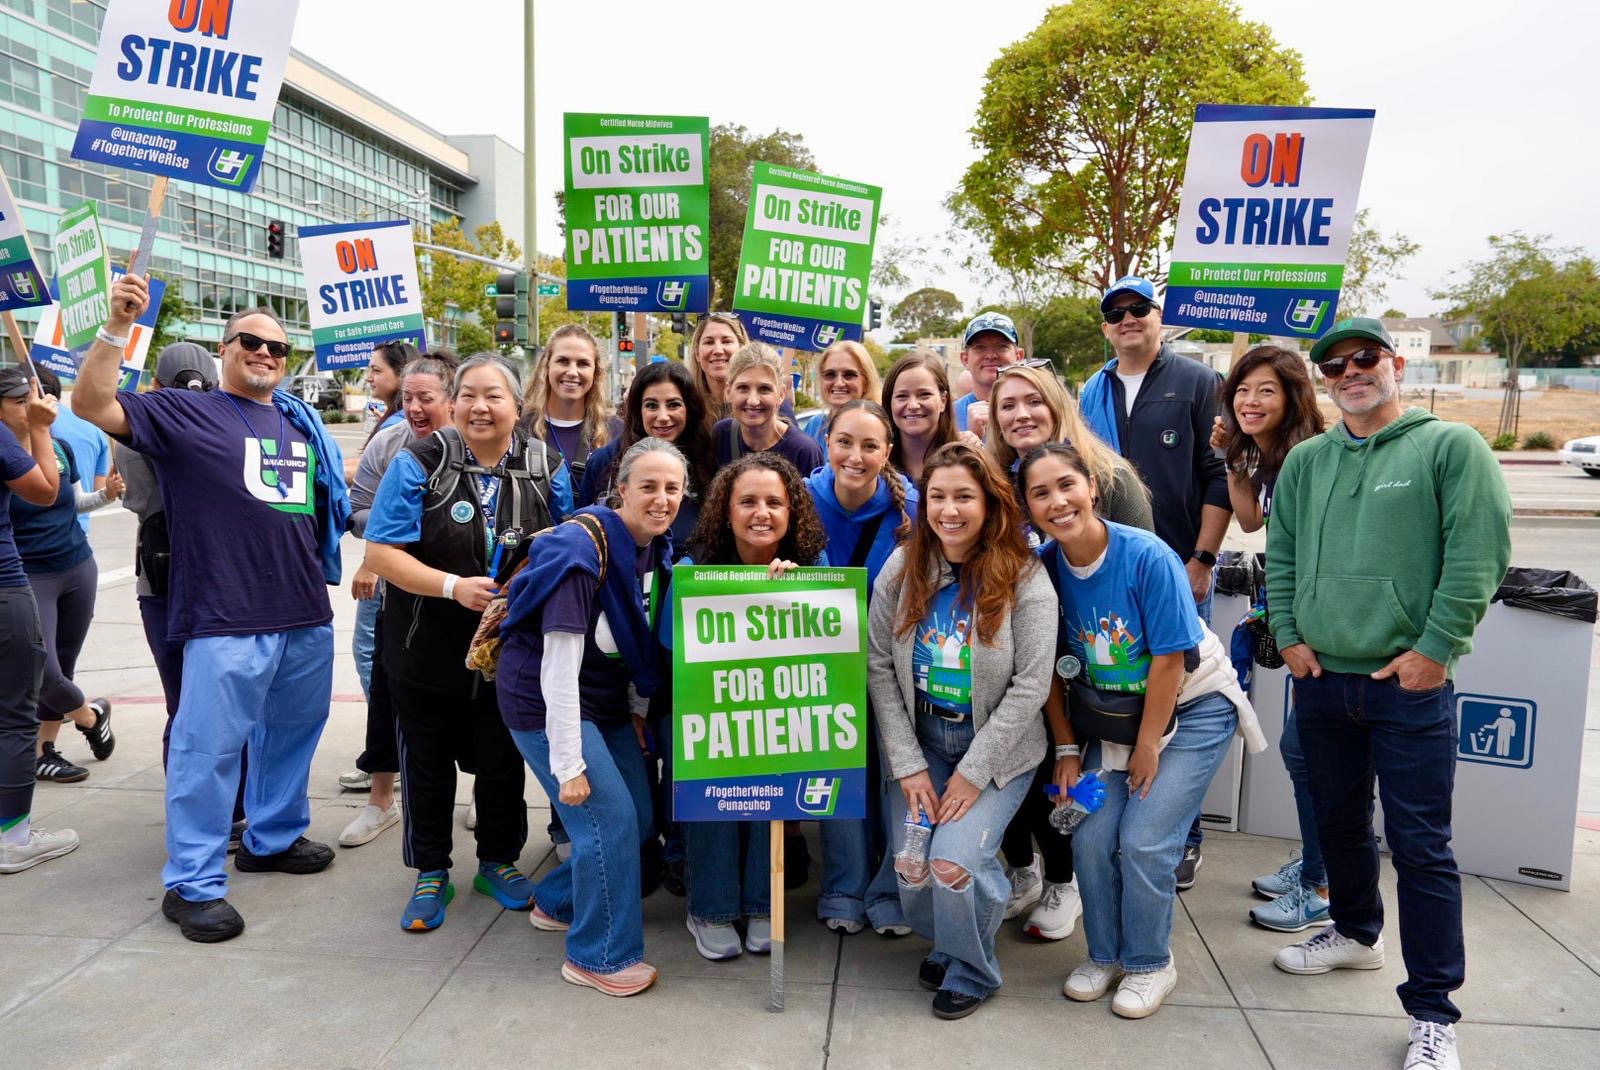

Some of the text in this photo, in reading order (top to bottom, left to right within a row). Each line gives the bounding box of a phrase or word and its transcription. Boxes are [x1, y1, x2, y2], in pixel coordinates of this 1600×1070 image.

[117, 34, 263, 101] STRIKE
[108, 103, 253, 137] To Protect Our Professions
[600, 118, 627, 128] Certified
[645, 119, 673, 129] Midwives
[91, 138, 190, 169] #TogetherWeRise
[111, 127, 177, 152] @unacuhcp
[580, 143, 690, 175] On Strike
[1241, 133, 1305, 188] ON
[594, 192, 680, 221] FOR OUR
[764, 193, 862, 232] On Strike
[1196, 198, 1334, 246] STRIKE
[58, 228, 97, 265] On Strike
[336, 237, 378, 275] ON
[572, 224, 703, 265] PATIENTS
[768, 238, 847, 271] FOR OUR
[66, 274, 81, 300] FOR
[82, 267, 97, 292] OUR
[589, 284, 649, 295] #TogetherWeRise
[743, 263, 862, 310] PATIENTS
[1190, 268, 1327, 283] To Protect Our Professions
[319, 274, 408, 315] STRIKE
[599, 295, 639, 305] @unacuhcp
[1194, 289, 1255, 308] @unacuhcp
[62, 291, 109, 337] PATIENTS
[335, 320, 405, 339] For Safe Patient Care
[752, 316, 806, 334] #TogetherWeRise
[1178, 303, 1268, 324] #TogetherWeRise
[759, 328, 795, 342] @unacuhcp
[694, 570, 728, 582] Certified
[729, 570, 769, 583] Registere
[796, 571, 845, 583] Anesthetists
[696, 601, 842, 645] On Strike
[713, 663, 828, 704] FOR OUR
[681, 703, 858, 761] PATIENTS
[704, 785, 784, 799] #TogetherWeRise
[717, 800, 771, 812] @unacuhcp
